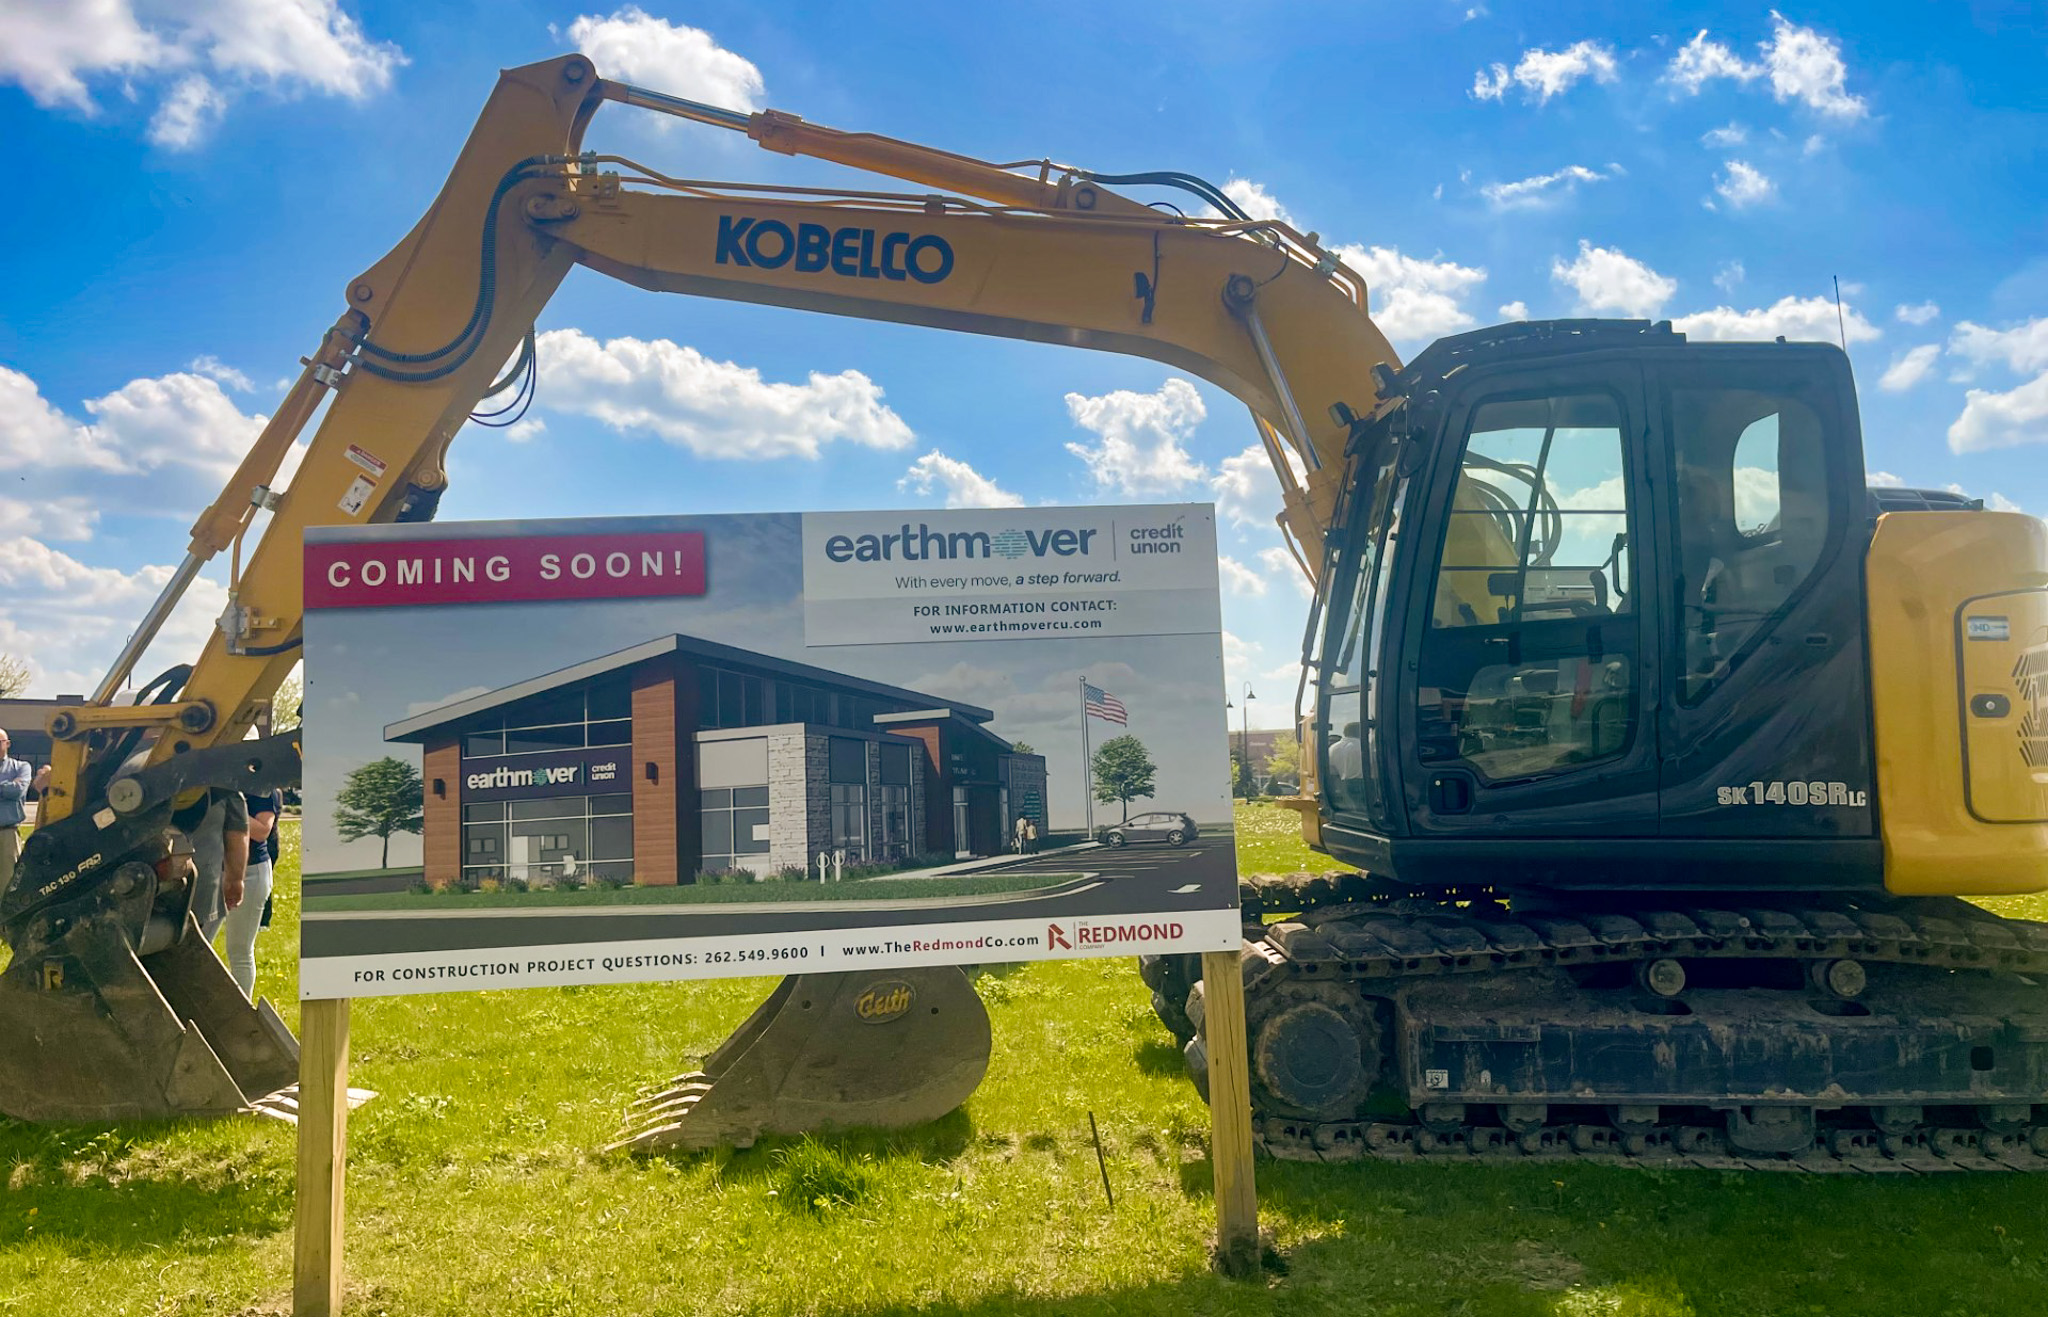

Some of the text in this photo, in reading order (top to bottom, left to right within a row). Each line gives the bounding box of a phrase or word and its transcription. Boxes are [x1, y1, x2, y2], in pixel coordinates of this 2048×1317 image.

[715, 215, 954, 284] KOBELCO
[1130, 523, 1184, 540] credit
[825, 523, 1097, 563] earthmover
[1130, 541, 1181, 554] union
[328, 550, 682, 587] COMING SOON!
[895, 570, 1121, 590] With every move, a step forward.
[913, 600, 1117, 617] FOR INFORMATION CONTACT:
[930, 619, 1102, 634] www.earthmovercu.com
[591, 762, 616, 772] credit
[591, 771, 615, 781] union
[467, 766, 577, 789] earthmover
[38, 882, 58, 896] TAC
[58, 871, 76, 885] 130
[1078, 923, 1184, 944] REDMOND
[354, 936, 1039, 982] FOR CONSTRUCTION PROJECT QUESTIONS: 262.549.9600 www.TheRedmondCo.com
